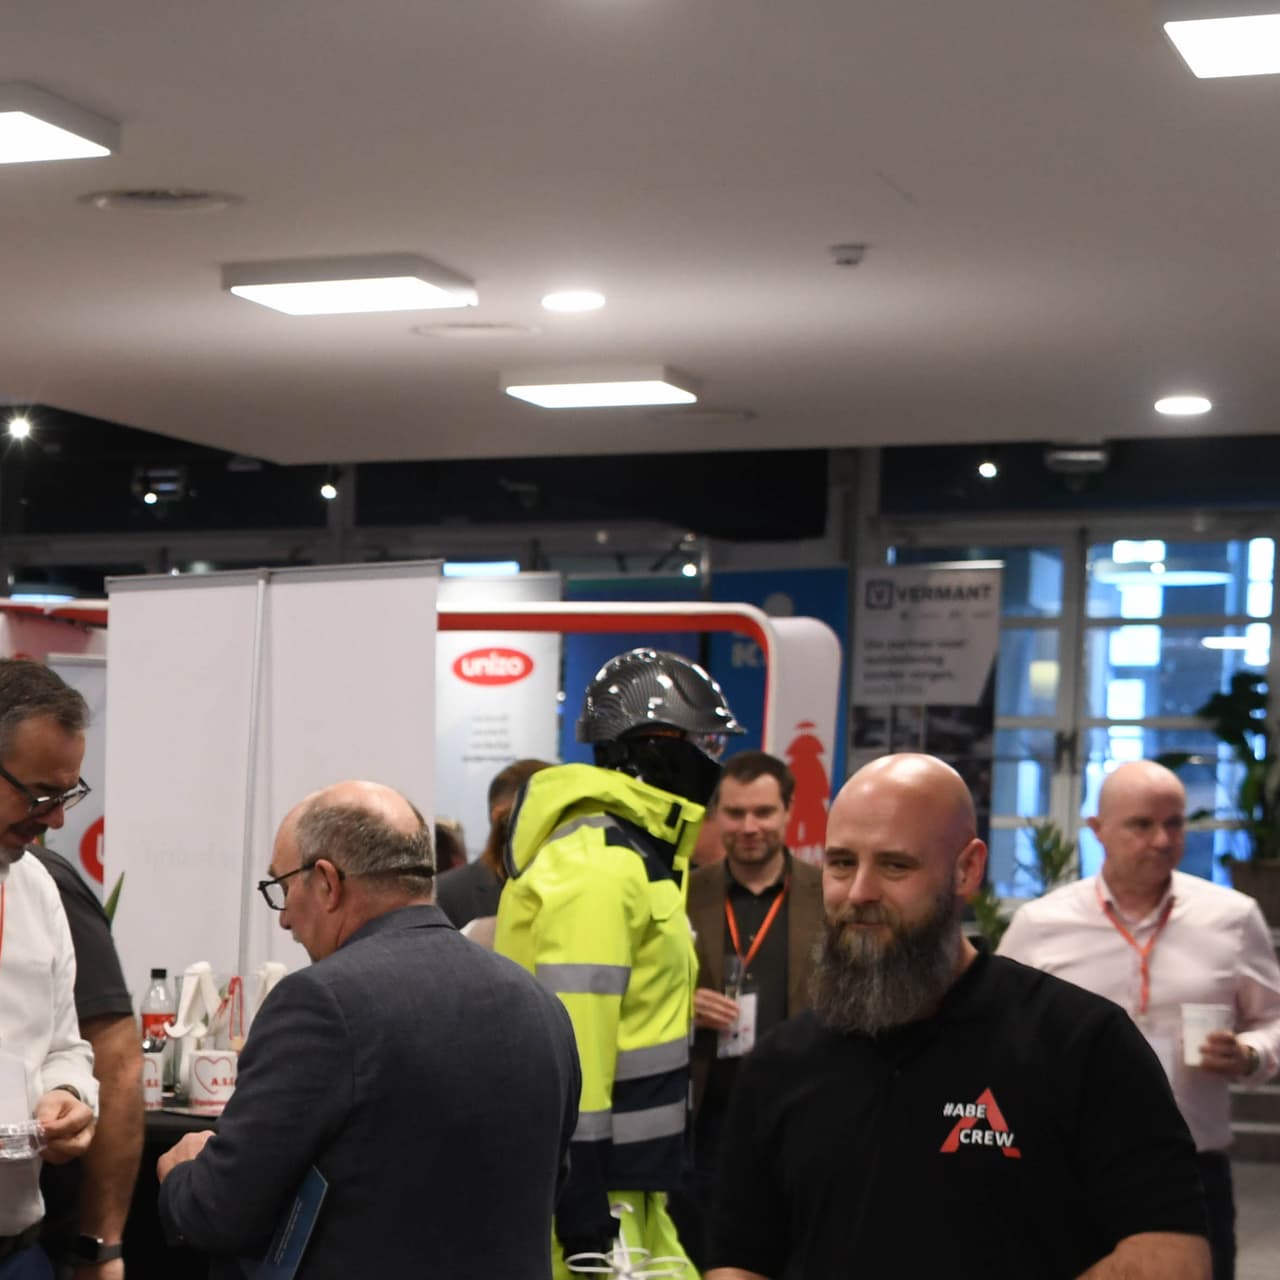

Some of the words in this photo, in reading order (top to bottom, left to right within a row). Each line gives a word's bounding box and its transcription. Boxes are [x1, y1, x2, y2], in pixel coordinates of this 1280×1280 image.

[461, 650, 525, 678] unizo
[942, 1102, 986, 1119] #ABE
[959, 1128, 1015, 1148] CREW
